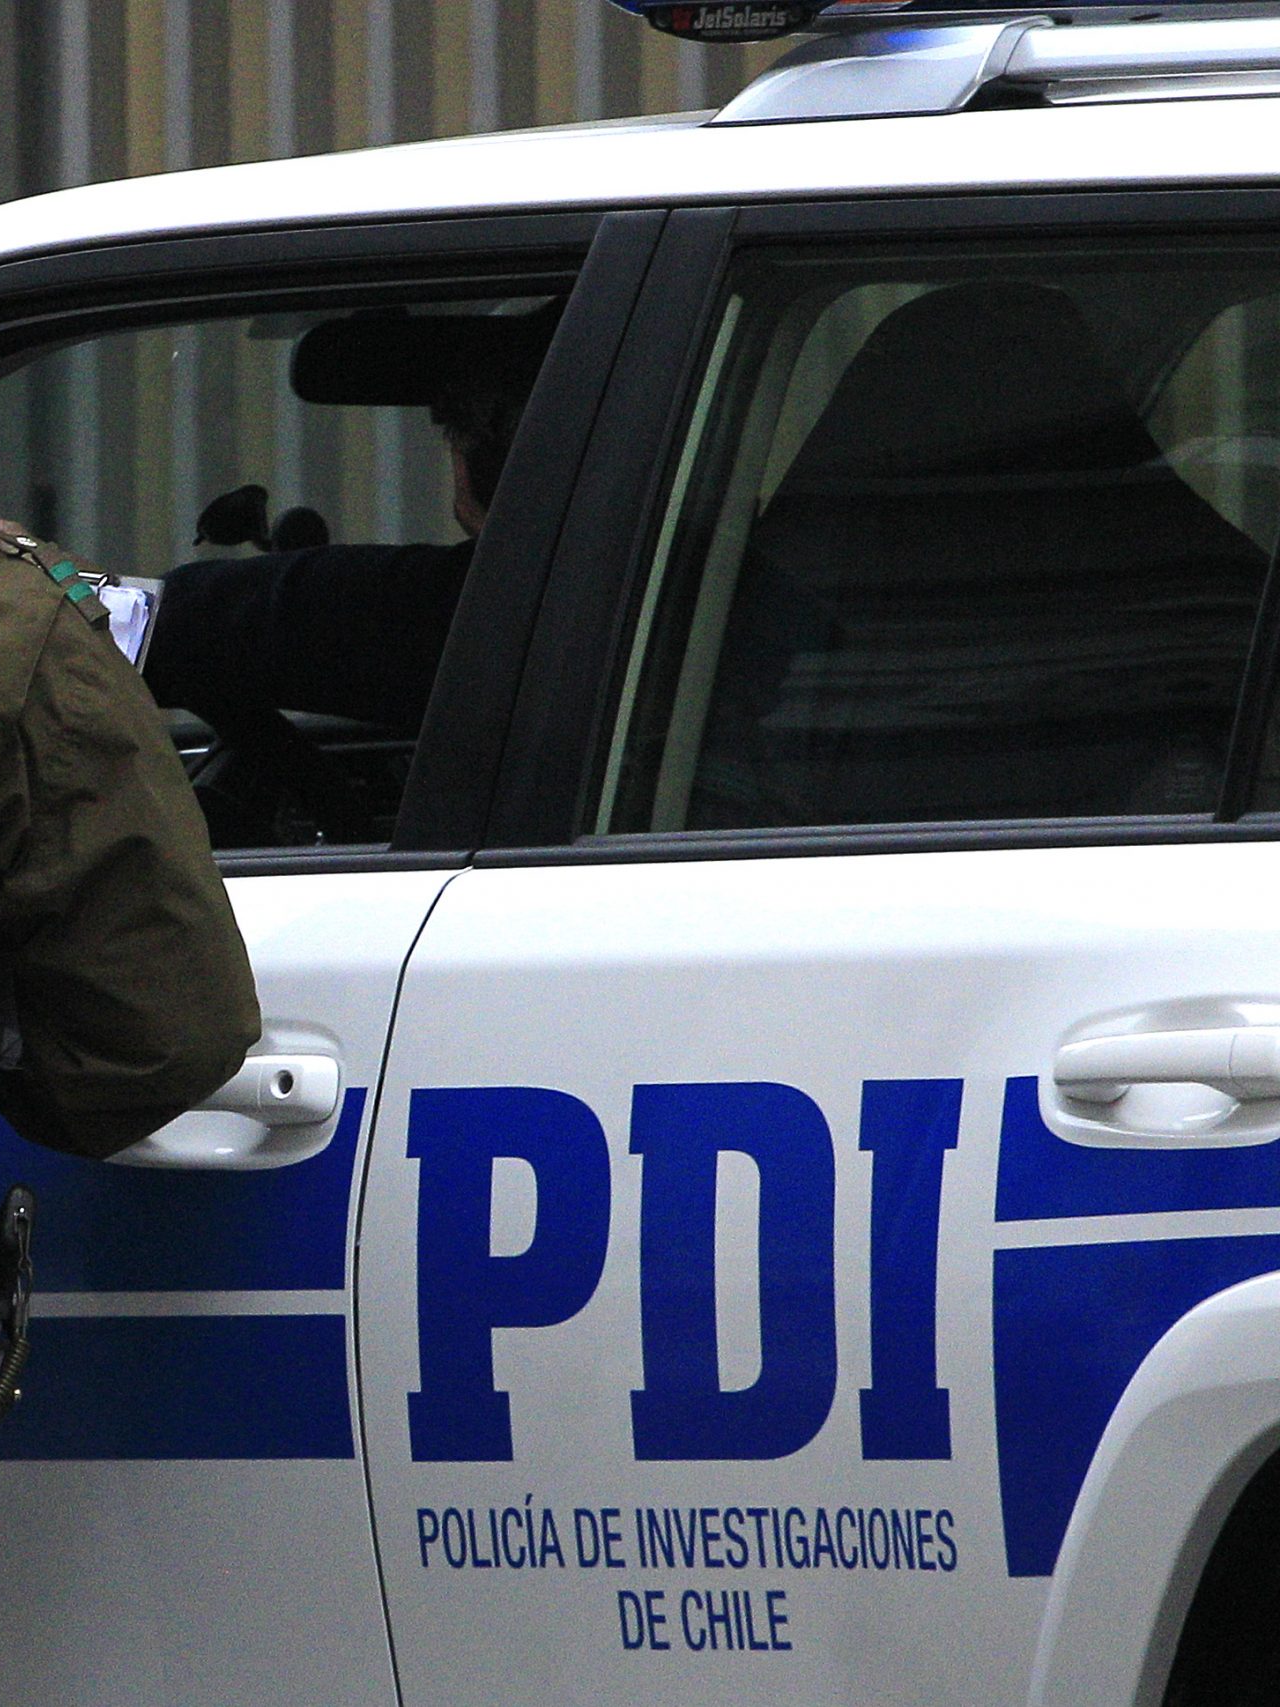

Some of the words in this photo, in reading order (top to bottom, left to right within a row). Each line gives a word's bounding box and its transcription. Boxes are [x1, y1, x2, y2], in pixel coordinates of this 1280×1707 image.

[693, 6, 787, 29] JetSolaris
[406, 1078, 964, 1462] PDI
[417, 1493, 565, 1569] POLICÍA
[574, 1507, 626, 1569] DE
[636, 1507, 958, 1572] INVESTIGACIONES
[617, 1589, 670, 1651] DE
[681, 1589, 793, 1651] CHILE
